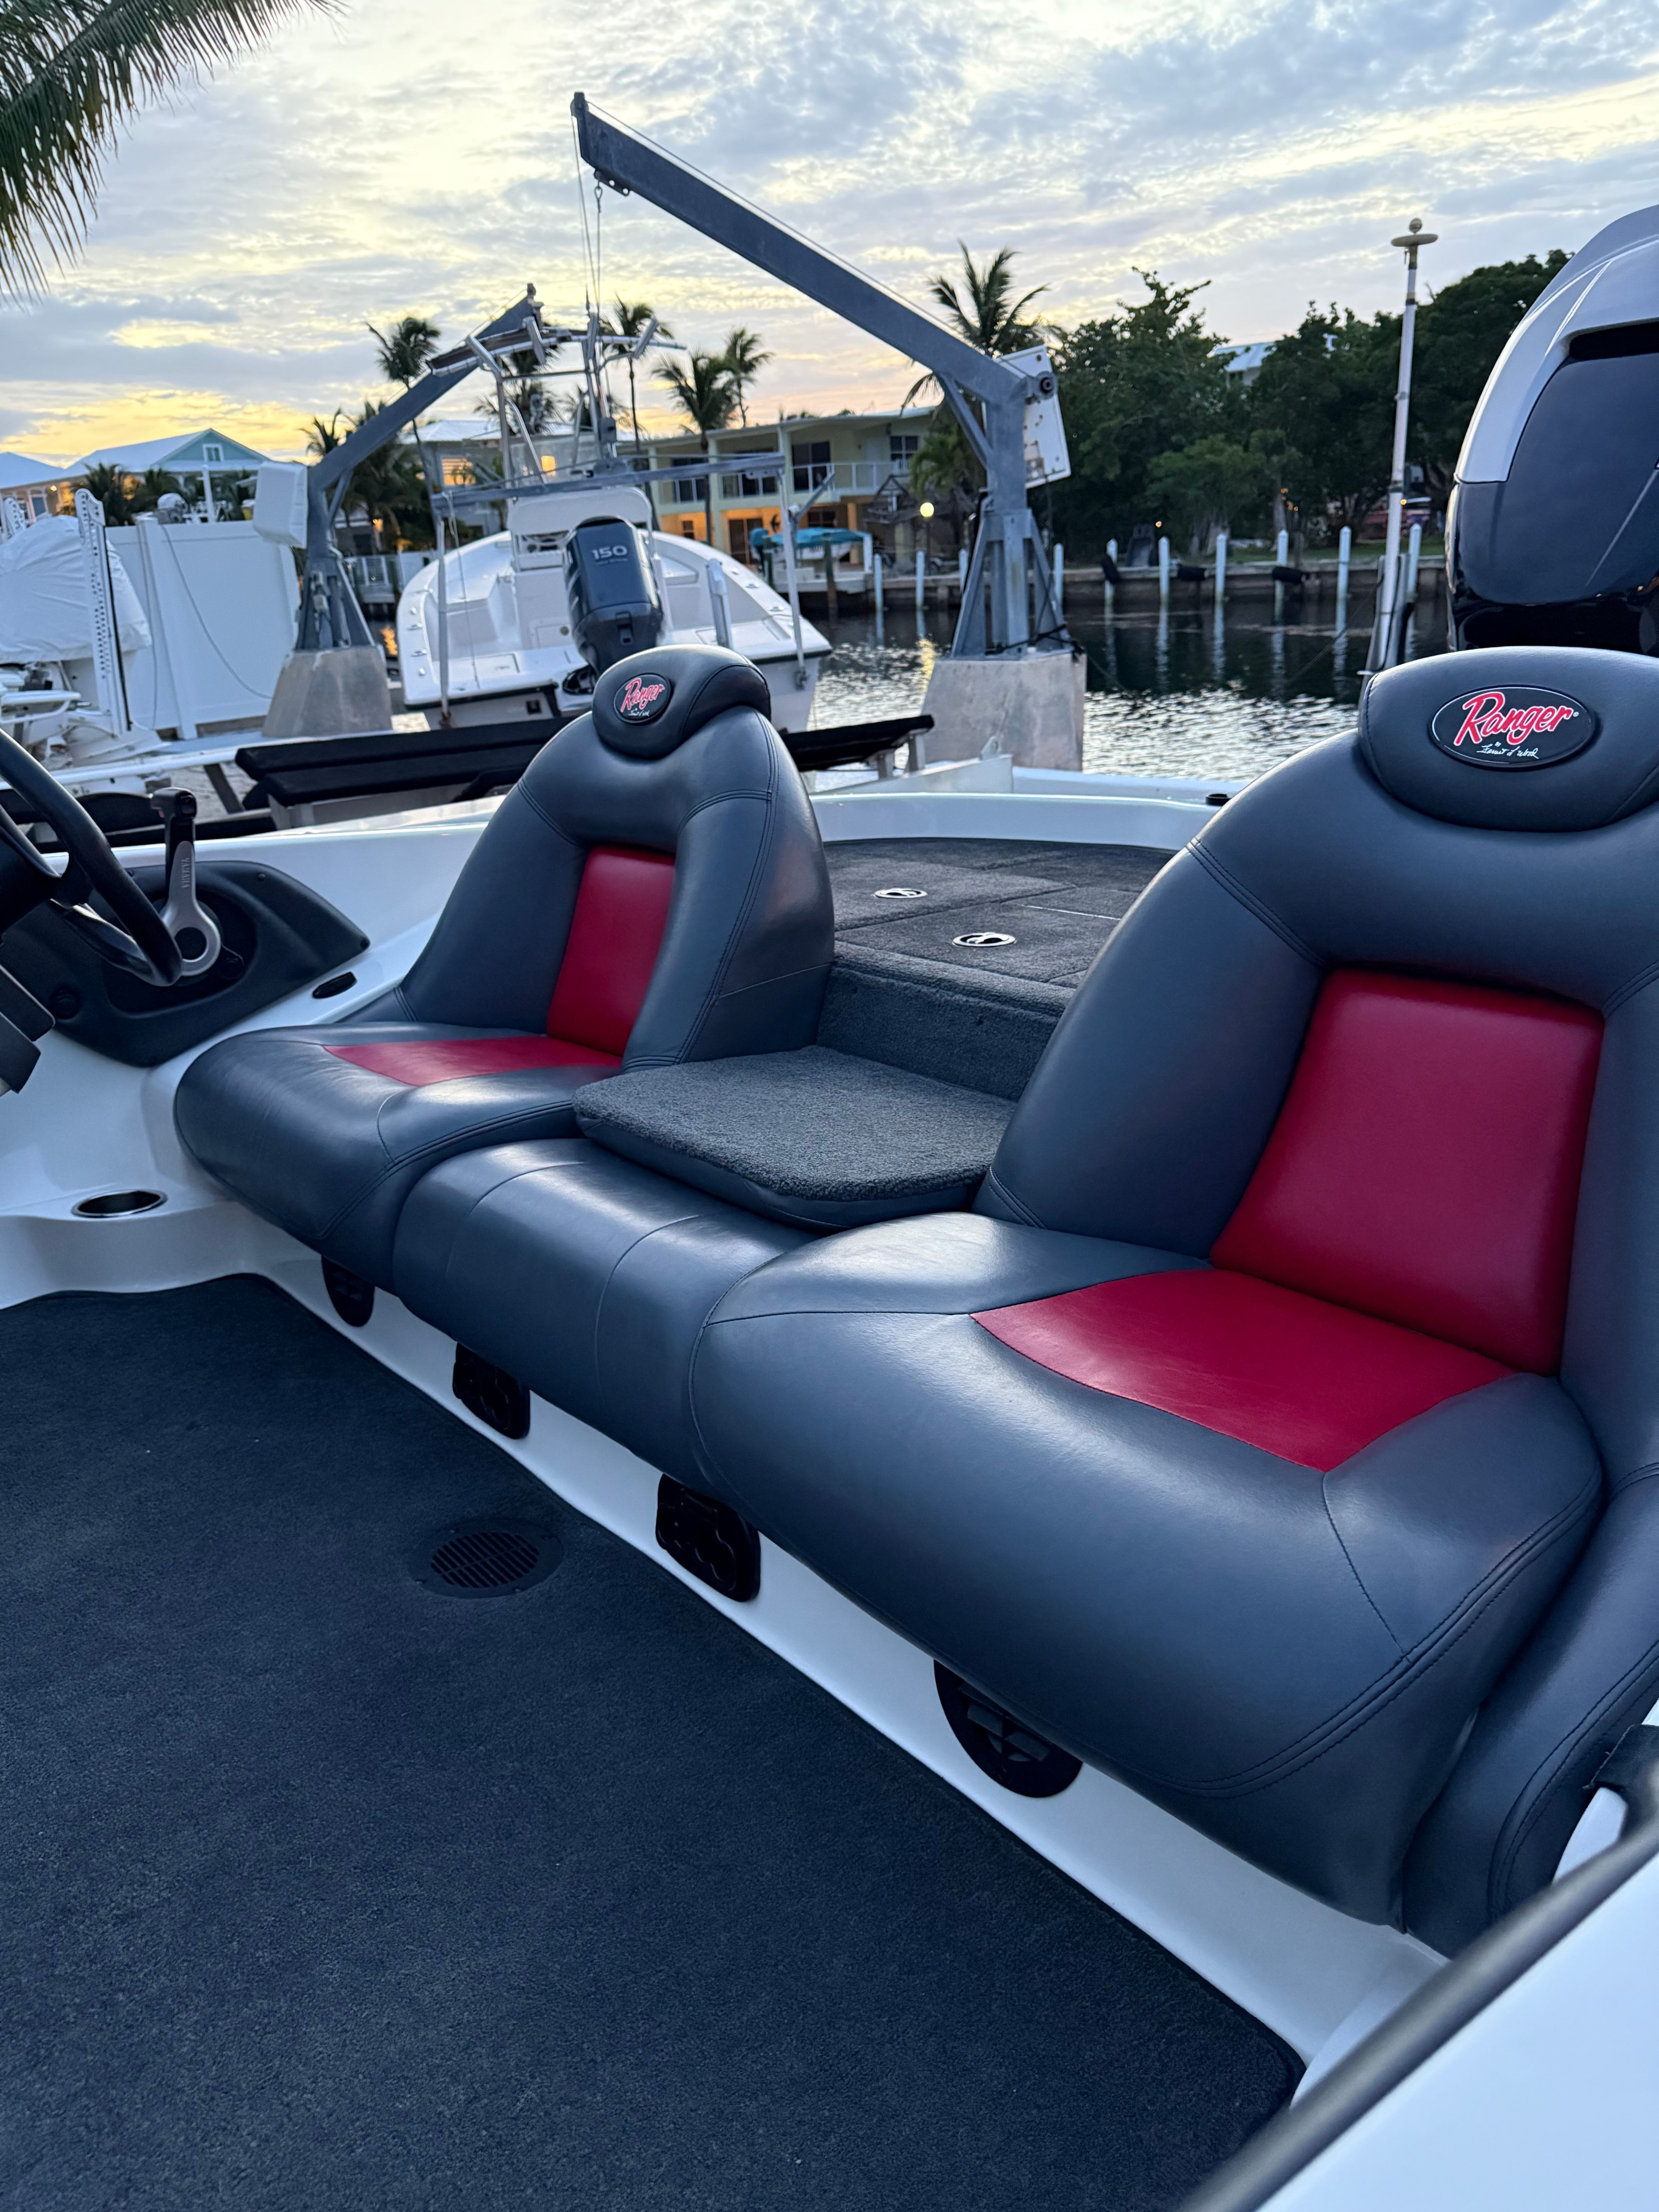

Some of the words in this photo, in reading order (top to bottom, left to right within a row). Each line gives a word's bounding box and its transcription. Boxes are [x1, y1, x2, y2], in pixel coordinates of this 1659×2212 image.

[592, 545, 628, 560] 150
[620, 678, 664, 713] Ranger
[1453, 691, 1574, 746] Ranger
[181, 857, 190, 888] YAMAHA
